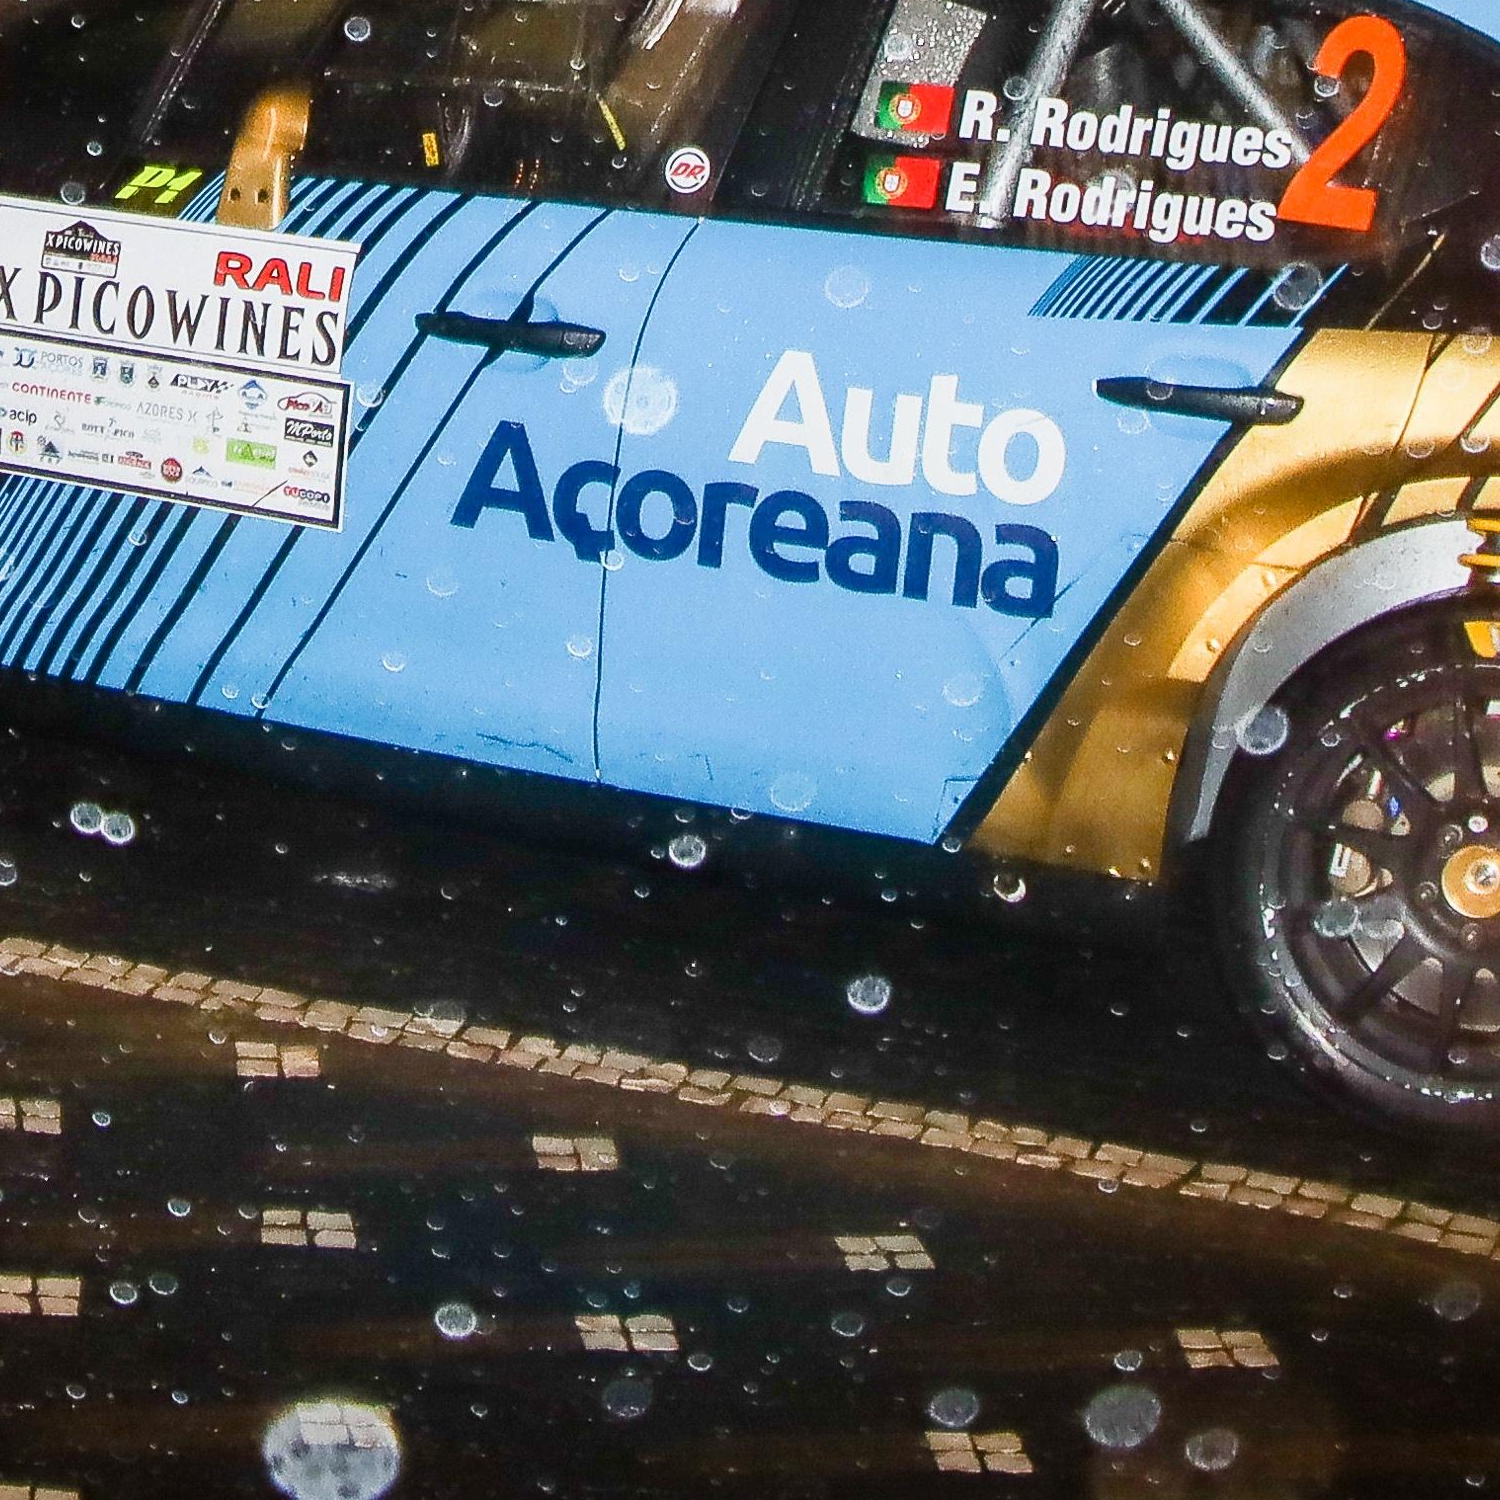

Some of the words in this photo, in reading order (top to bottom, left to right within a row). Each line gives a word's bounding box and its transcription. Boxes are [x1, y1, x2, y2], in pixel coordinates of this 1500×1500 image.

[959, 88, 1010, 145] R.
[1029, 98, 1295, 171] Rodrigues
[1275, 13, 1407, 233] 2
[670, 161, 706, 181] DR
[1013, 168, 1278, 244] Rodrigues
[213, 250, 346, 302] RALI
[33, 272, 340, 368] PICOWINES
[11, 381, 92, 405] CONTINENTE
[727, 348, 1067, 506] Auto
[449, 419, 1061, 619] Açoreana
